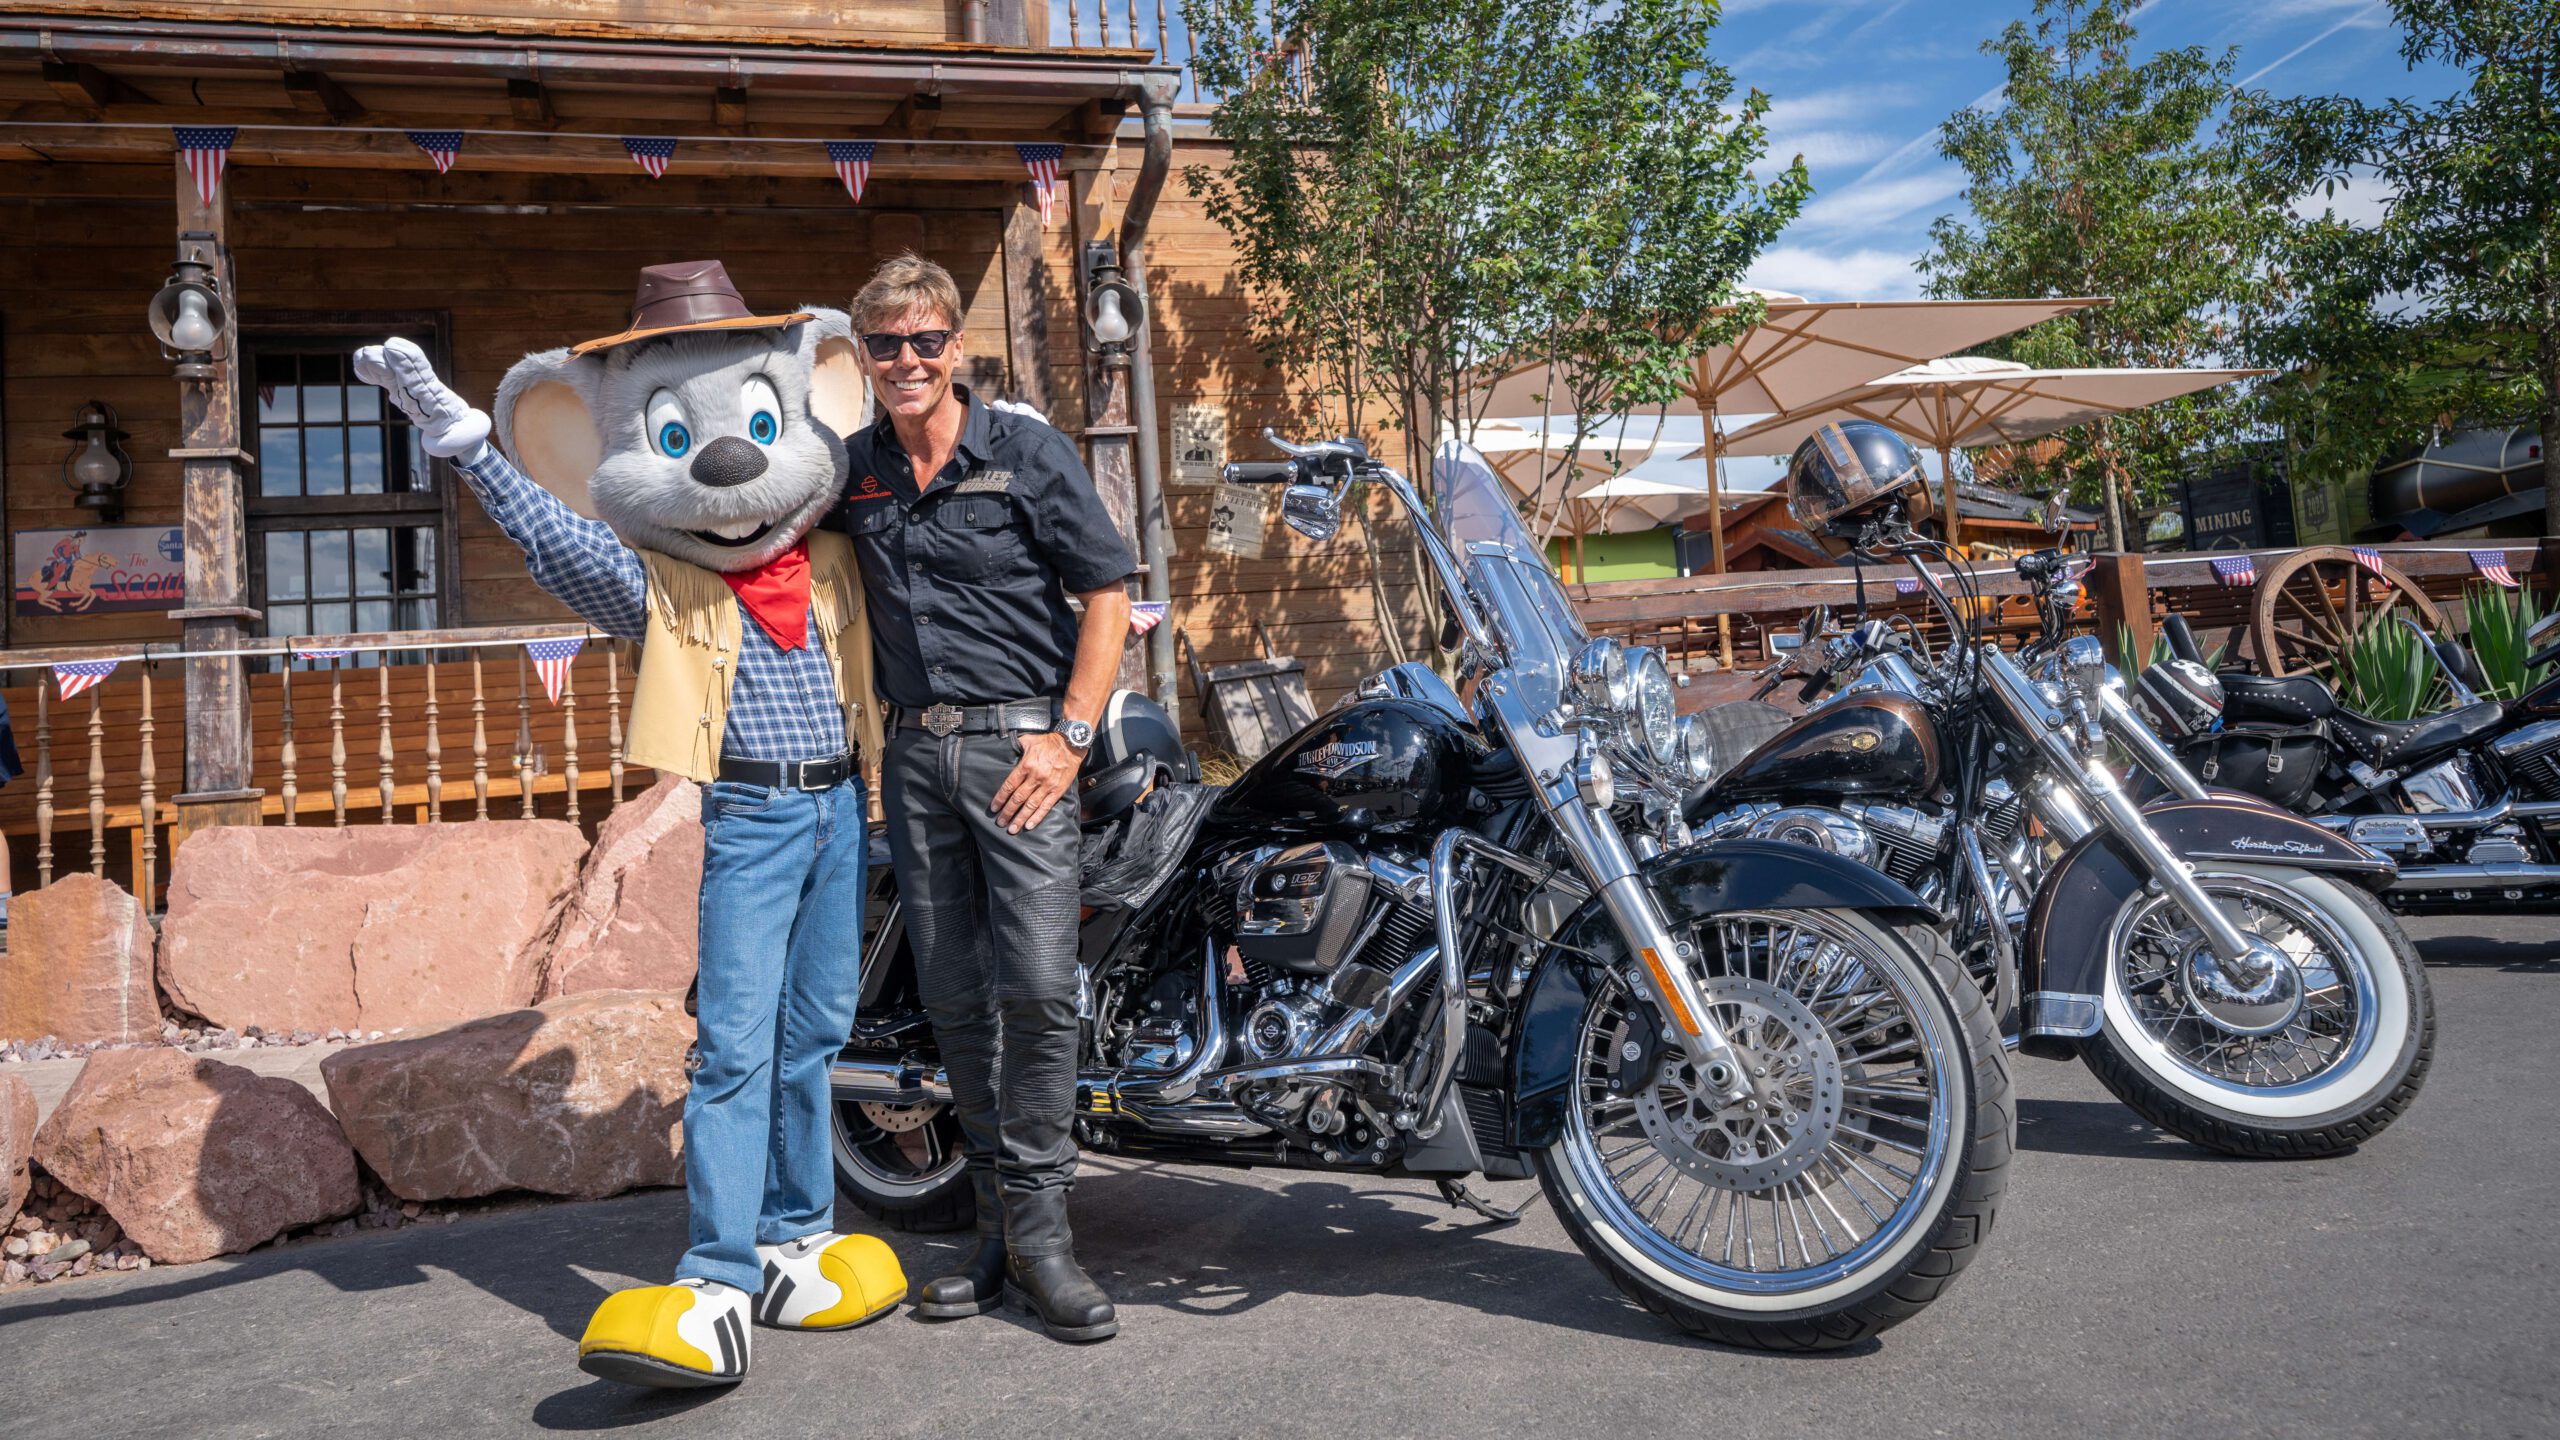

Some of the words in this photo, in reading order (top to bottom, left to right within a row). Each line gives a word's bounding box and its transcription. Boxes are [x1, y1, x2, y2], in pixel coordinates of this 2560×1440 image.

[2194, 508, 2253, 534] MINING
[127, 552, 149, 568] The
[106, 569, 184, 600] SCOU
[1298, 740, 1377, 767] HARLEY-DAVIDSON
[2231, 836, 2284, 855] Heritage
[2283, 840, 2325, 855] Softail
[1291, 871, 1321, 884] 107
